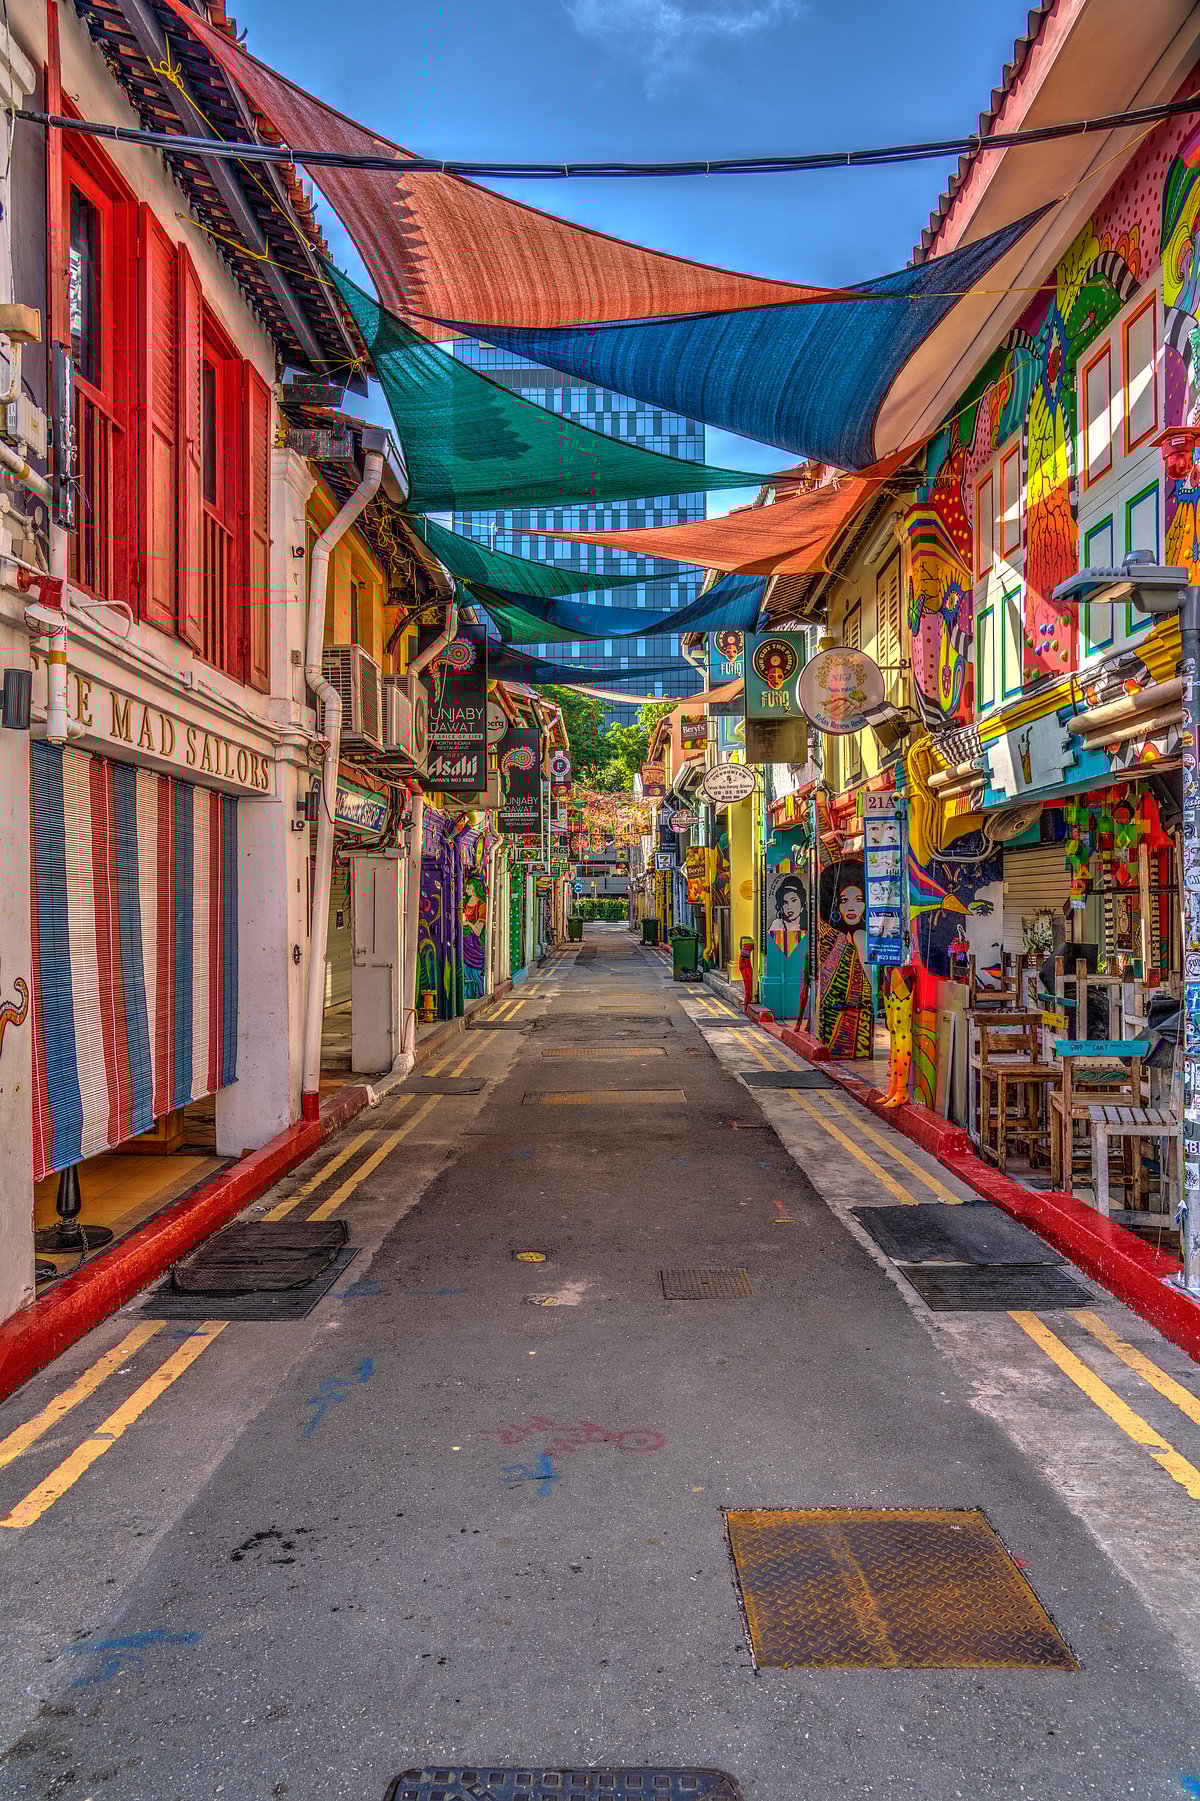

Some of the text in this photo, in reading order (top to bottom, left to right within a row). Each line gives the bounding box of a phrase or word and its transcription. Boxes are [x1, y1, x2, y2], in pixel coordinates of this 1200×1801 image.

[758, 644, 793, 671] WE GOT THE FUNK
[720, 662, 744, 678] FUNQ
[761, 690, 792, 711] FUNQ
[431, 723, 476, 732] DAWAT
[815, 713, 829, 727] Relax
[830, 721, 850, 729] Renew
[683, 724, 706, 735] Beryl's
[110, 691, 176, 757] MAD
[186, 727, 270, 791] SAILORS
[428, 755, 478, 776] Asahi
[868, 796, 897, 809] 21A
